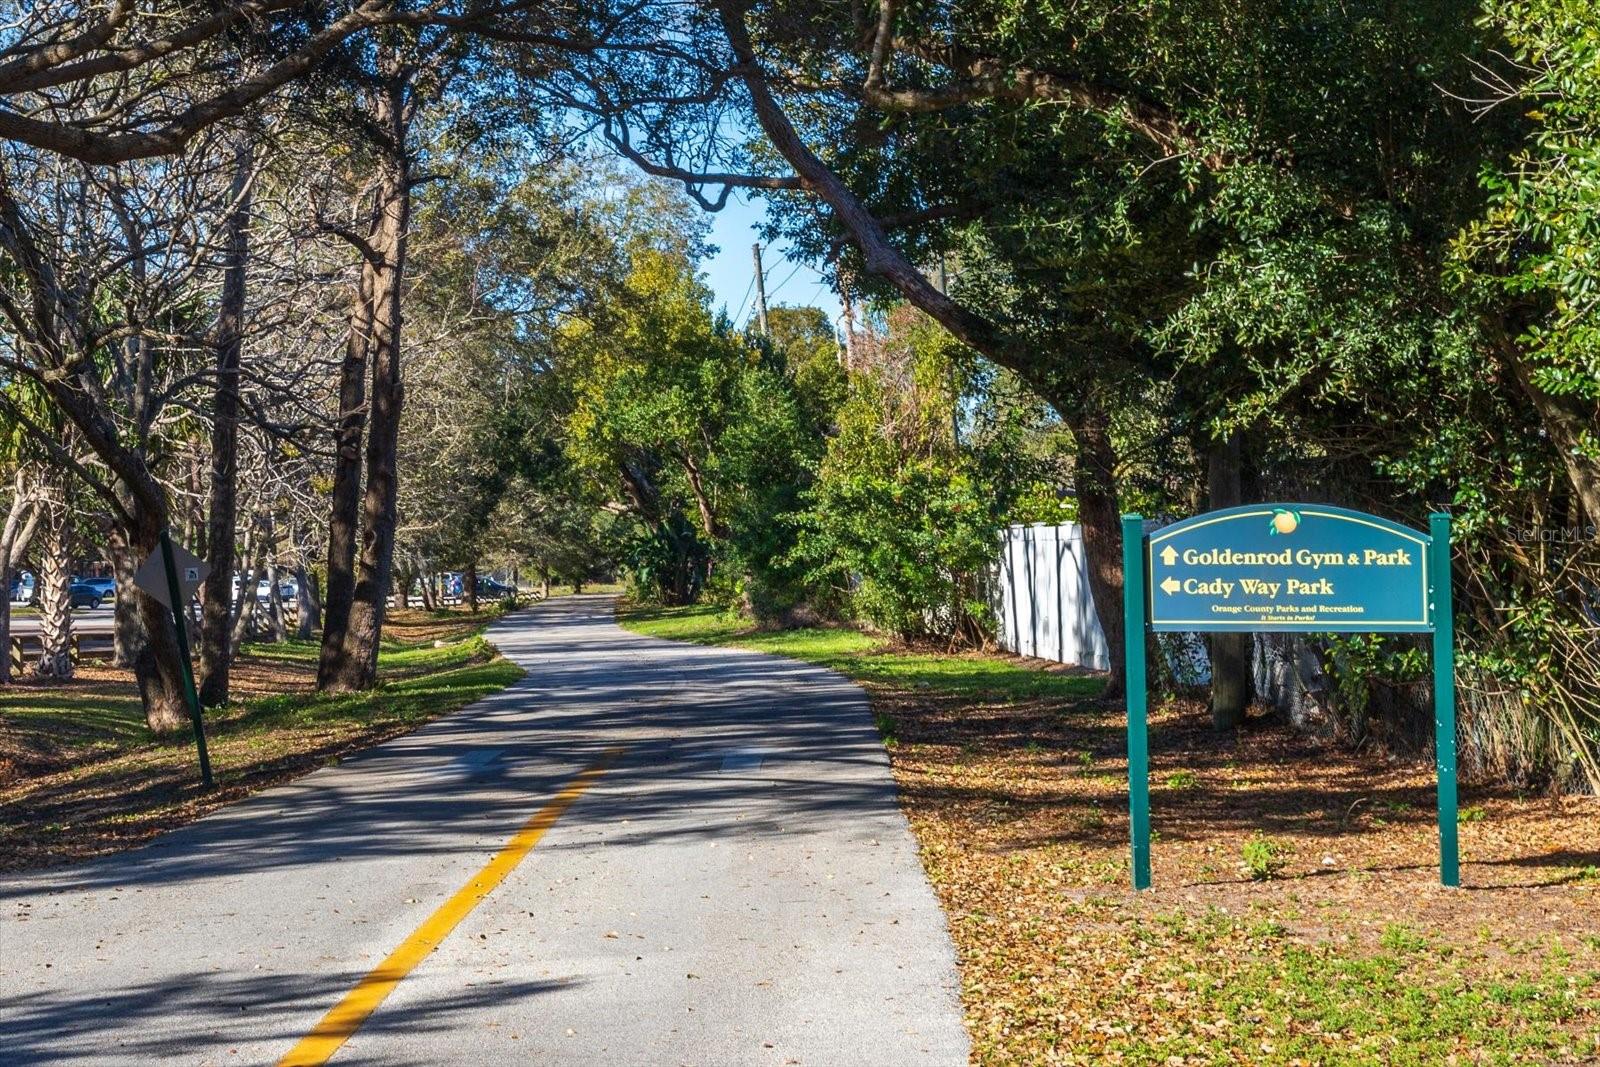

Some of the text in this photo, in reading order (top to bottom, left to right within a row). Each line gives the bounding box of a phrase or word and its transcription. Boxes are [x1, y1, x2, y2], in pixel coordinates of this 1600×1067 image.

[1183, 548, 1411, 569] Goldenrod Gym & Park
[1183, 578, 1334, 598] Cady Way Park
[1211, 605, 1242, 614] Orange
[1244, 605, 1274, 614] County
[1276, 604, 1299, 612] Parks
[1319, 604, 1364, 612] Recreation
